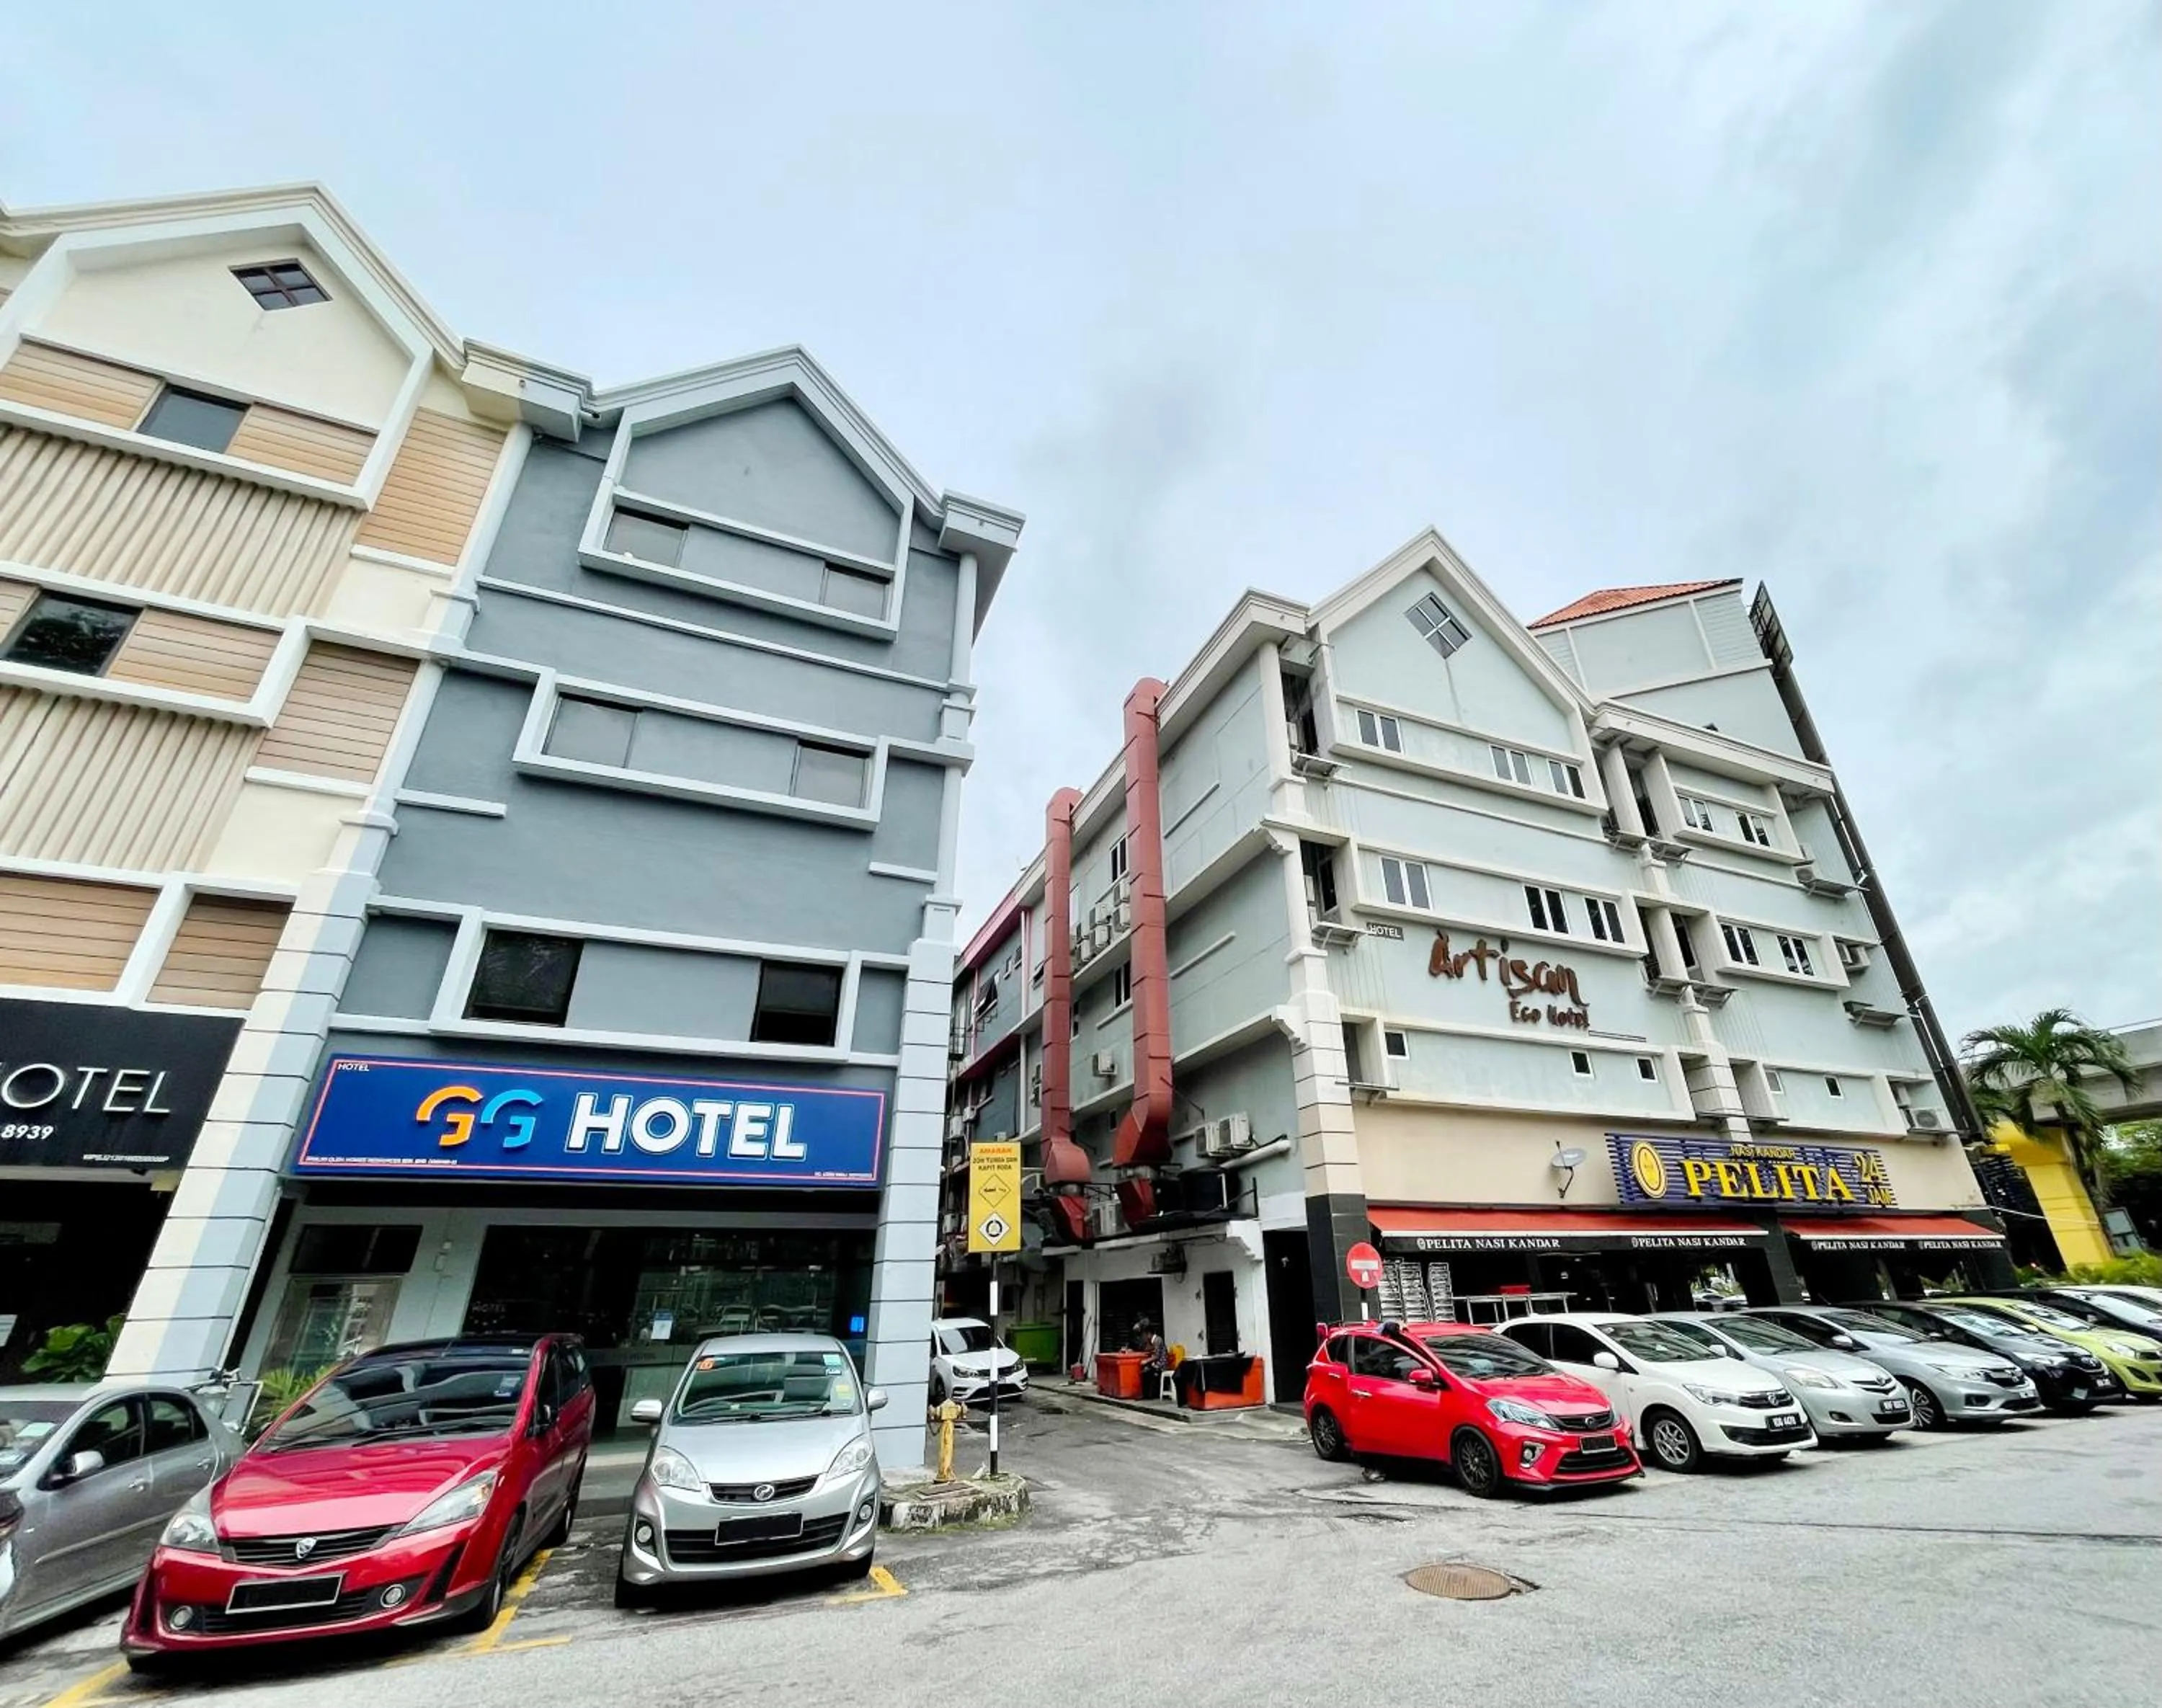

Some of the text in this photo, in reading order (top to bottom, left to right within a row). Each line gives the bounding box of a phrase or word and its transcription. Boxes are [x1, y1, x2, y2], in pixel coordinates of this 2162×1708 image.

[1369, 924, 1401, 938] HOTEL
[1509, 1001, 1591, 1028] Eco Hotel
[337, 1063, 370, 1072] HOTEL
[0, 1062, 171, 1113] OTEL
[415, 1085, 808, 1162] GG HOTEL
[1, 1124, 54, 1140] 8939
[1730, 1144, 1796, 1160] NASI KANDAR
[1854, 1153, 1882, 1183] 24
[1681, 1159, 1856, 1201] PELITA
[1867, 1186, 1893, 1204] JAM
[1427, 1239, 1560, 1249] PELITA NASI KANDAR
[1638, 1237, 1746, 1247] PELITA NASI KANDAR
[1849, 1240, 1868, 1249] NASI
[1870, 1240, 1905, 1249] KANDAR
